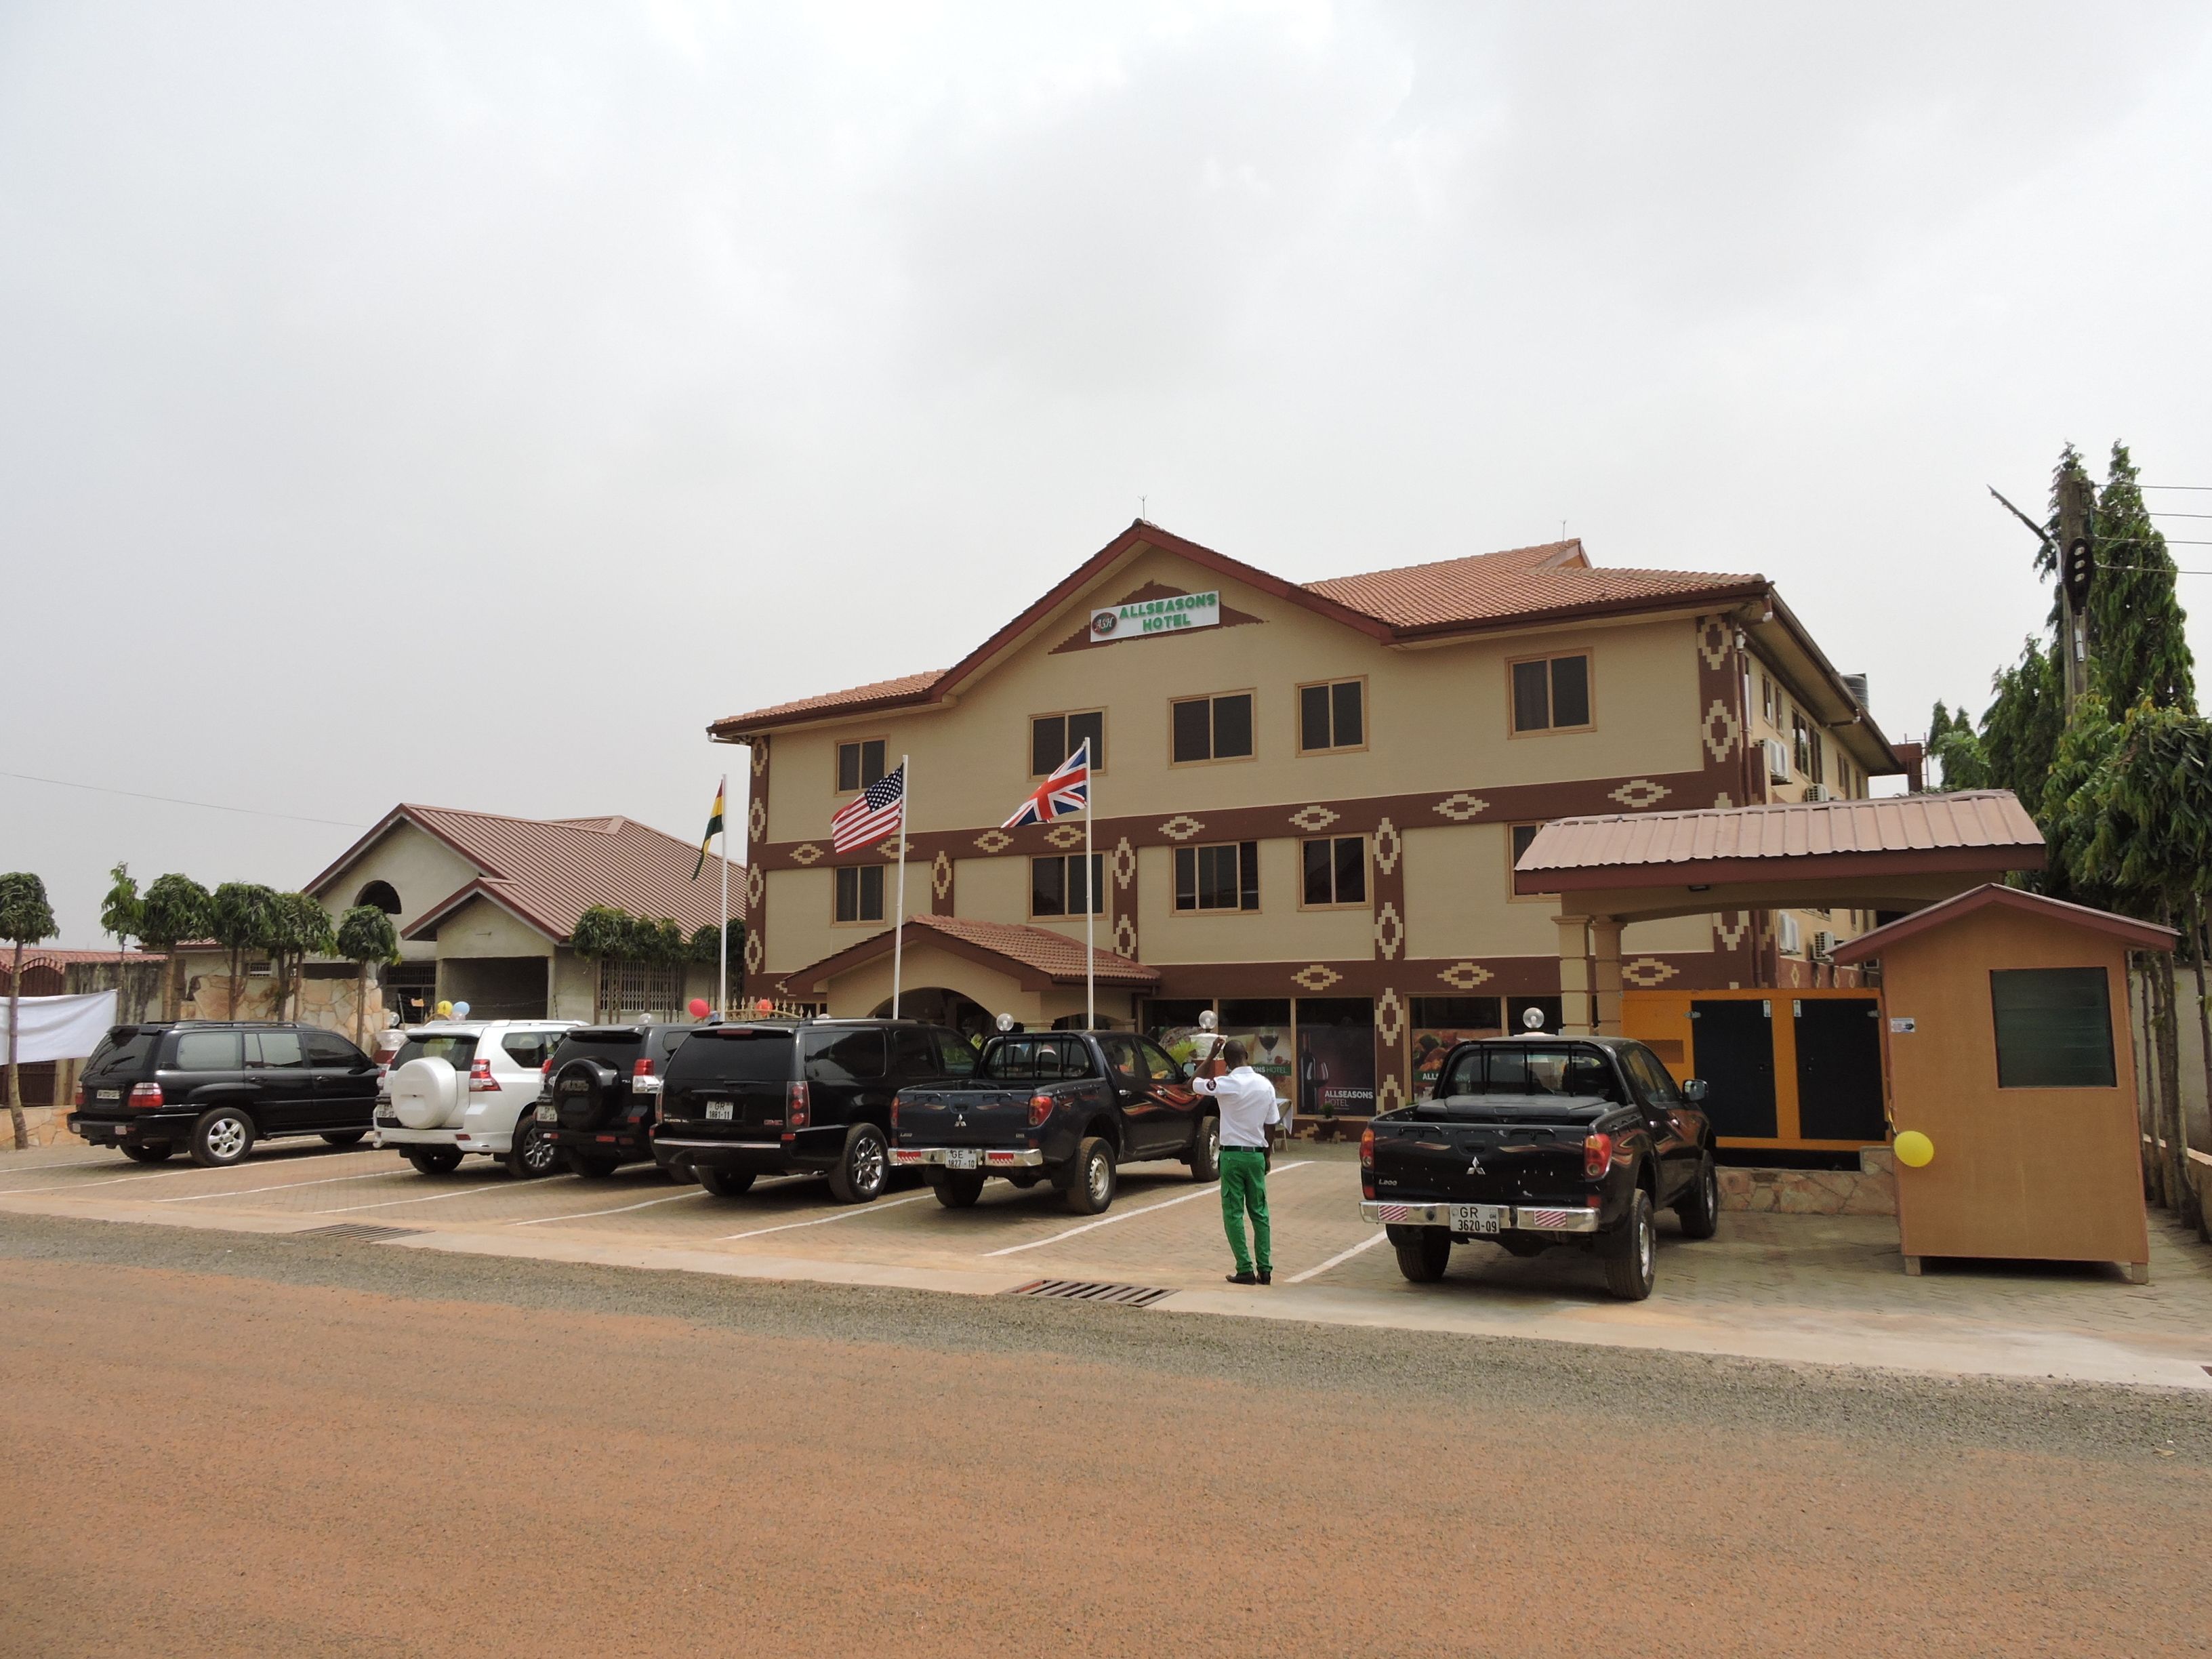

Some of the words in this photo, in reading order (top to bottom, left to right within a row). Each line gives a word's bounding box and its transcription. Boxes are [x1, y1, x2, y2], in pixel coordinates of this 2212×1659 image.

[1119, 593, 1216, 619] ALLSEASONS
[1143, 613, 1191, 631] HOTEL
[1325, 1090, 1374, 1099] ALLSEASONS
[951, 1150, 963, 1159] GE
[1460, 1207, 1478, 1218] GR
[1458, 1219, 1497, 1232] 3620-09
